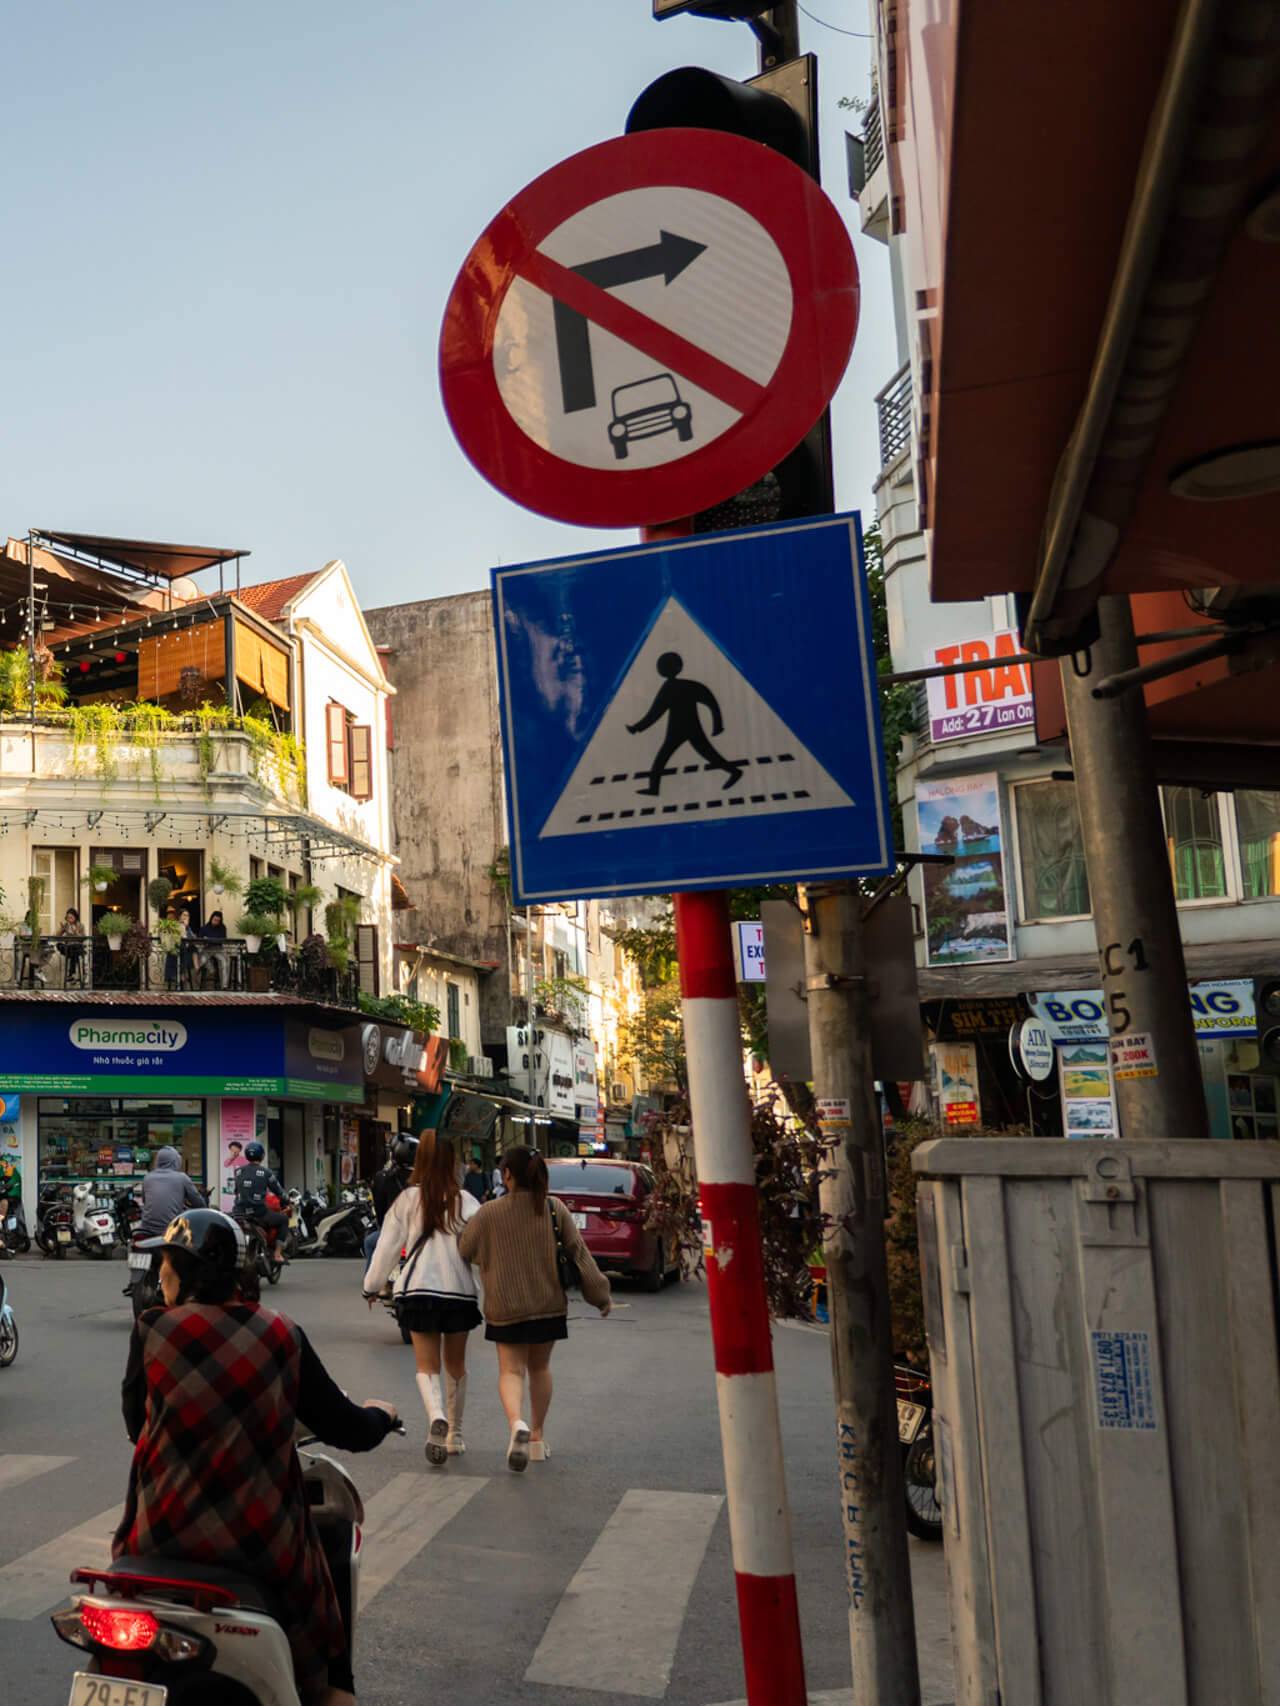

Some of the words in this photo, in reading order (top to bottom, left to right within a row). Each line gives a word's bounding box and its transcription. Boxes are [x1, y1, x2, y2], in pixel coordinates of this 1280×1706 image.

[941, 720, 965, 735] Add:
[966, 706, 995, 729] 27
[997, 708, 1016, 723] Lan
[928, 784, 965, 799] HALONG
[951, 1009, 983, 1028] SIM
[1109, 992, 1131, 1034] 5
[77, 1025, 179, 1048] Pharmacity
[1027, 1028, 1047, 1048] ATM
[1127, 1036, 1146, 1047] BAY
[93, 1056, 110, 1065] Nhà
[111, 1055, 135, 1066] thuốc
[136, 1056, 150, 1067] giá
[1122, 1050, 1149, 1062] 200K
